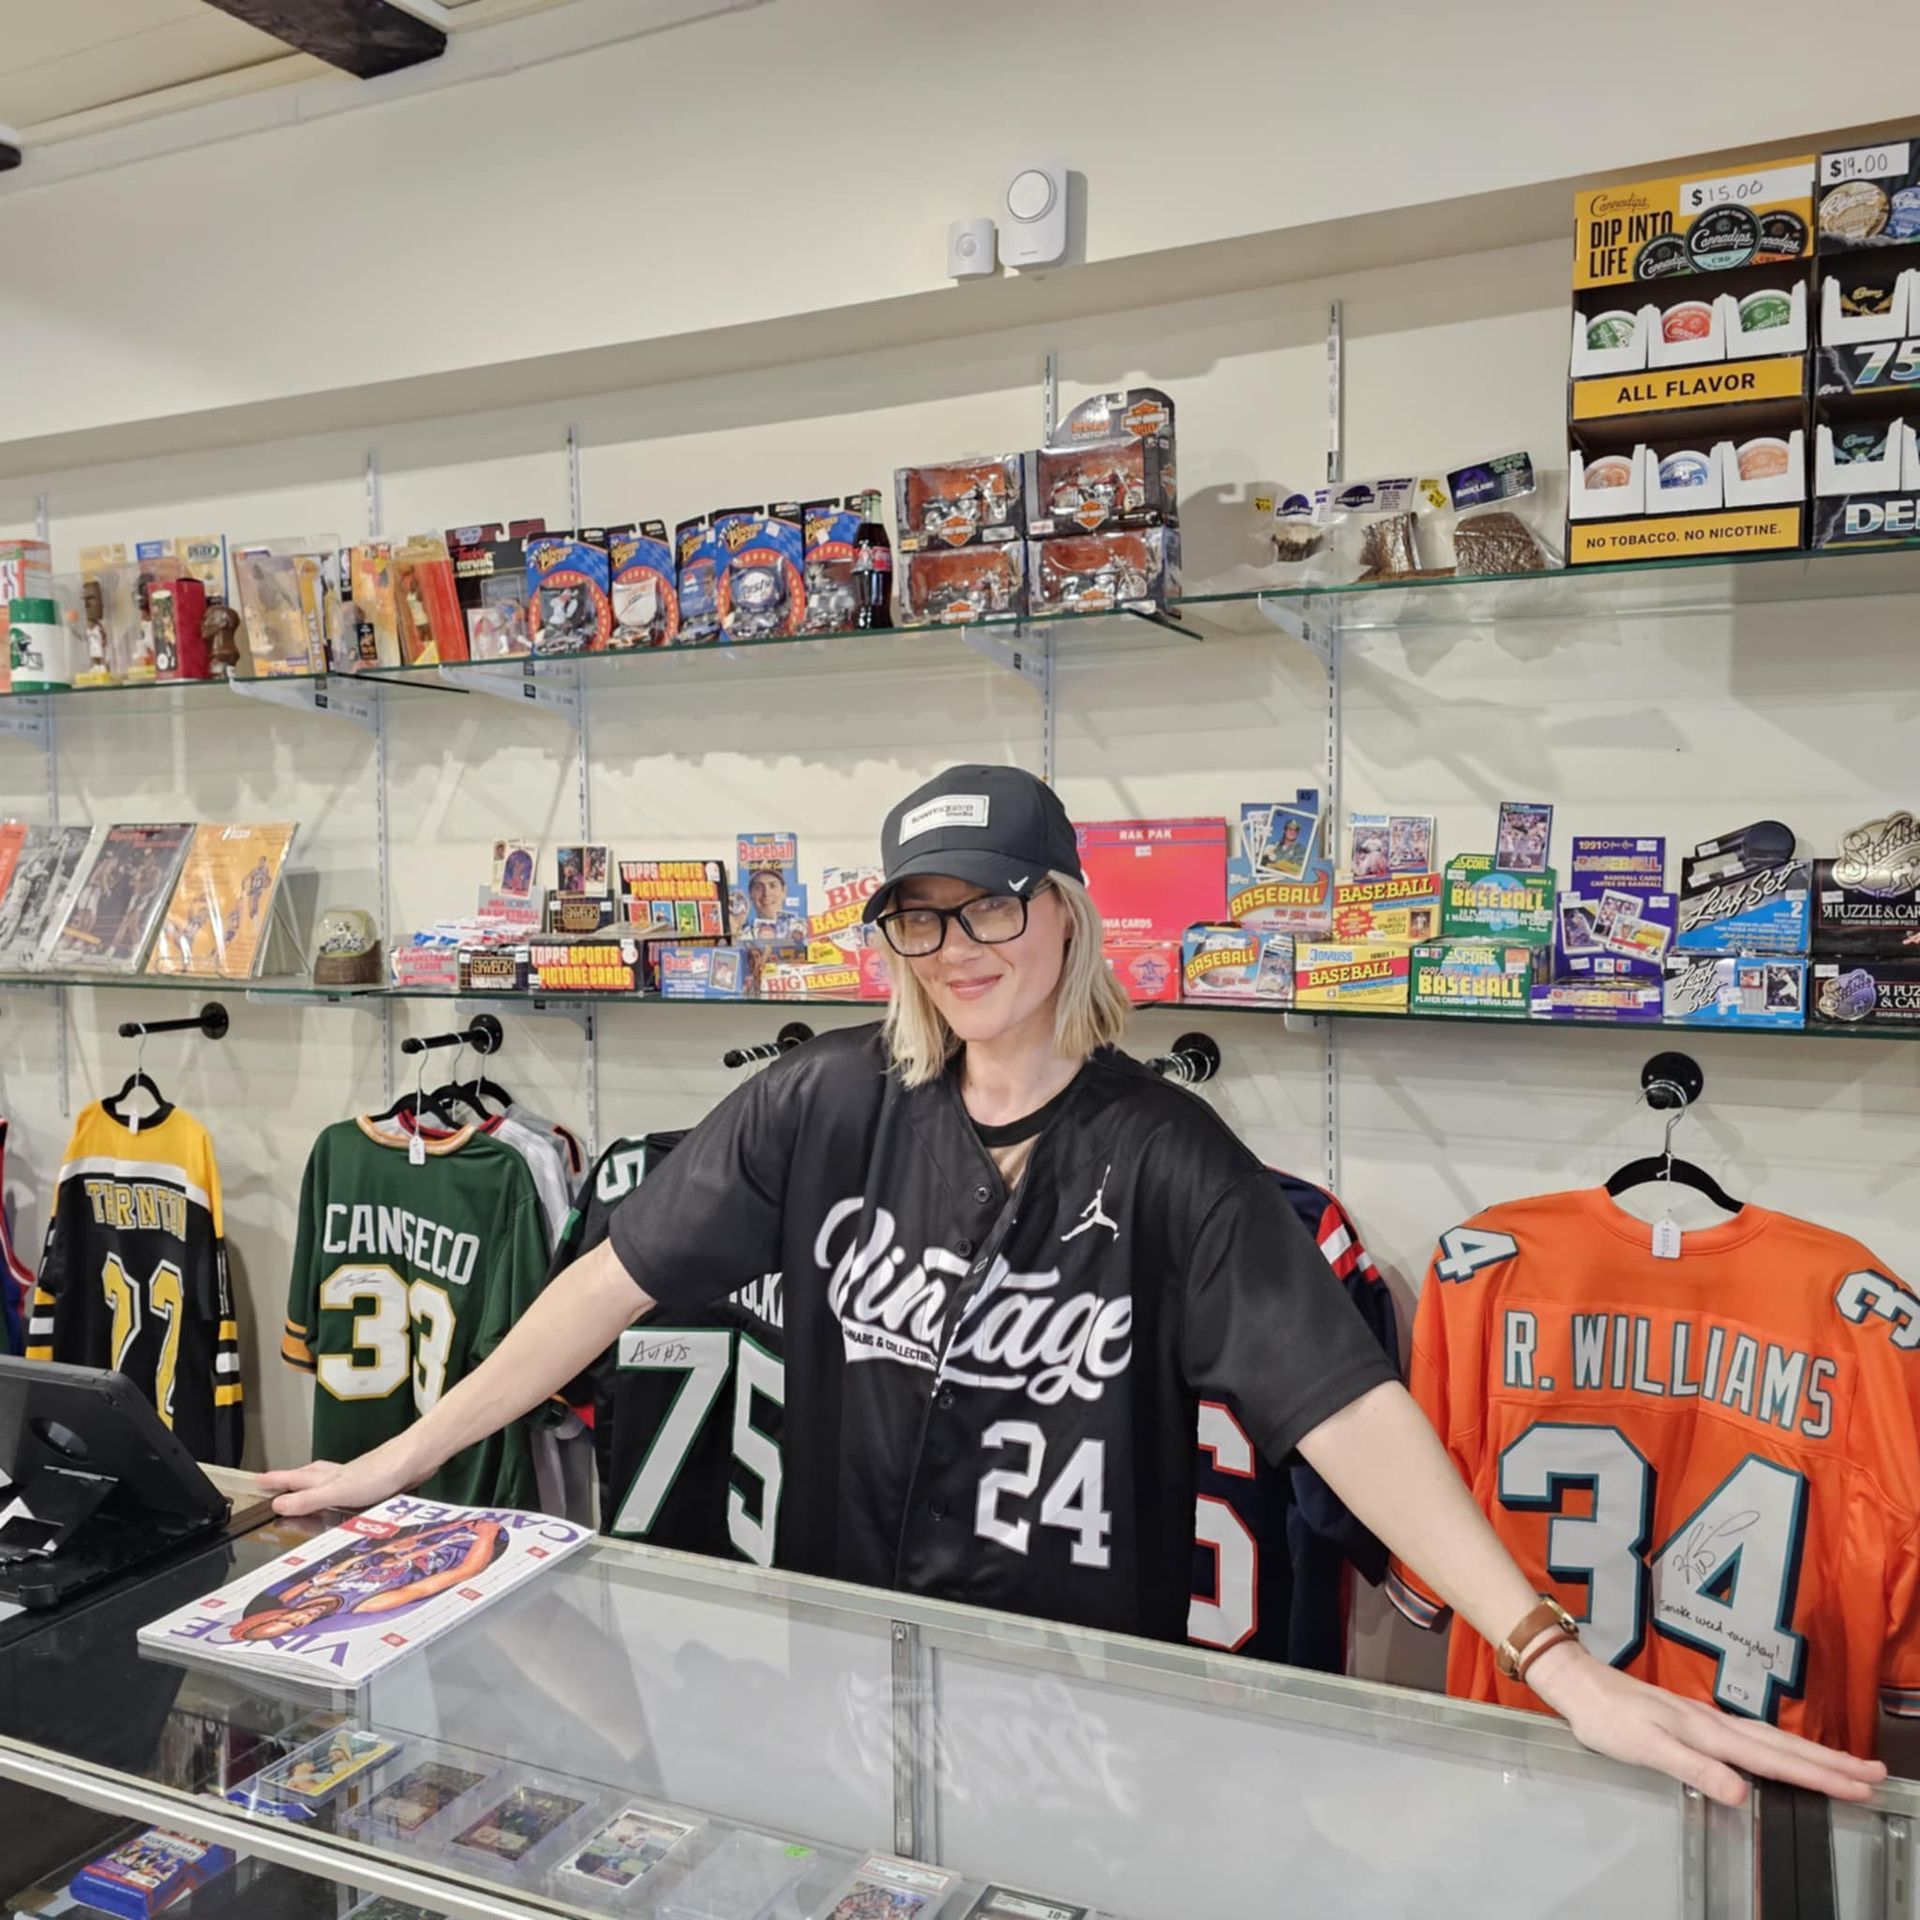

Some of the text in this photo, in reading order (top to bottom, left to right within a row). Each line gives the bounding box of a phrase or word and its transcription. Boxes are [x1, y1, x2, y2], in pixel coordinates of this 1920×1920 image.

[1591, 219, 1622, 249] DIP
[1628, 211, 1673, 244] INTO
[1691, 227, 1754, 253] Cannadips
[1760, 232, 1800, 253] nnadips
[1590, 247, 1628, 279] LIFE
[1639, 251, 1687, 280] Cannadip
[1617, 373, 1755, 404] ALL FLAVOR
[1845, 499, 1920, 534] DE
[1587, 523, 1782, 548] NO TOBACCO. NO NICOTINE.
[1119, 829, 1172, 841] RAK PAK
[738, 840, 794, 862] Baseball
[1458, 856, 1492, 870] SCORE
[622, 862, 705, 881] TOPPS SPORTS
[1747, 861, 1804, 906] Set
[631, 881, 717, 899] PICTURE CARDS
[826, 876, 880, 908] BIG
[1231, 885, 1321, 918] BASEBALL
[1338, 878, 1433, 903] BASEBALL
[1451, 888, 1545, 911] BASEBALL
[811, 902, 866, 936] BASE
[1791, 902, 1803, 918] 2
[1834, 905, 1882, 918] PUZZLE
[1884, 905, 1895, 918] &
[1121, 918, 1152, 929] CARDS
[531, 946, 622, 967] TOPPS SPORTS
[1185, 949, 1255, 980] BASEBALL
[1456, 948, 1495, 965] SCORE
[538, 966, 634, 989] PICTURE CARDS
[767, 970, 859, 993] BIG BASEBA
[1309, 961, 1393, 986] BASEBALL
[1418, 974, 1522, 998] BASEBALL
[323, 1203, 480, 1285] CANSECO
[1434, 1225, 1518, 1284] 4
[813, 1196, 1132, 1405] Vintage
[317, 1263, 456, 1418] 33
[876, 1336, 885, 1348] &
[1504, 1310, 1837, 1439] R. WILLIAMS
[612, 1326, 786, 1568] 75
[974, 1419, 1111, 1569] 24
[386, 1498, 580, 1543] CARTER
[1498, 1421, 1812, 1728] 34
[1695, 1615, 1724, 1635] weed
